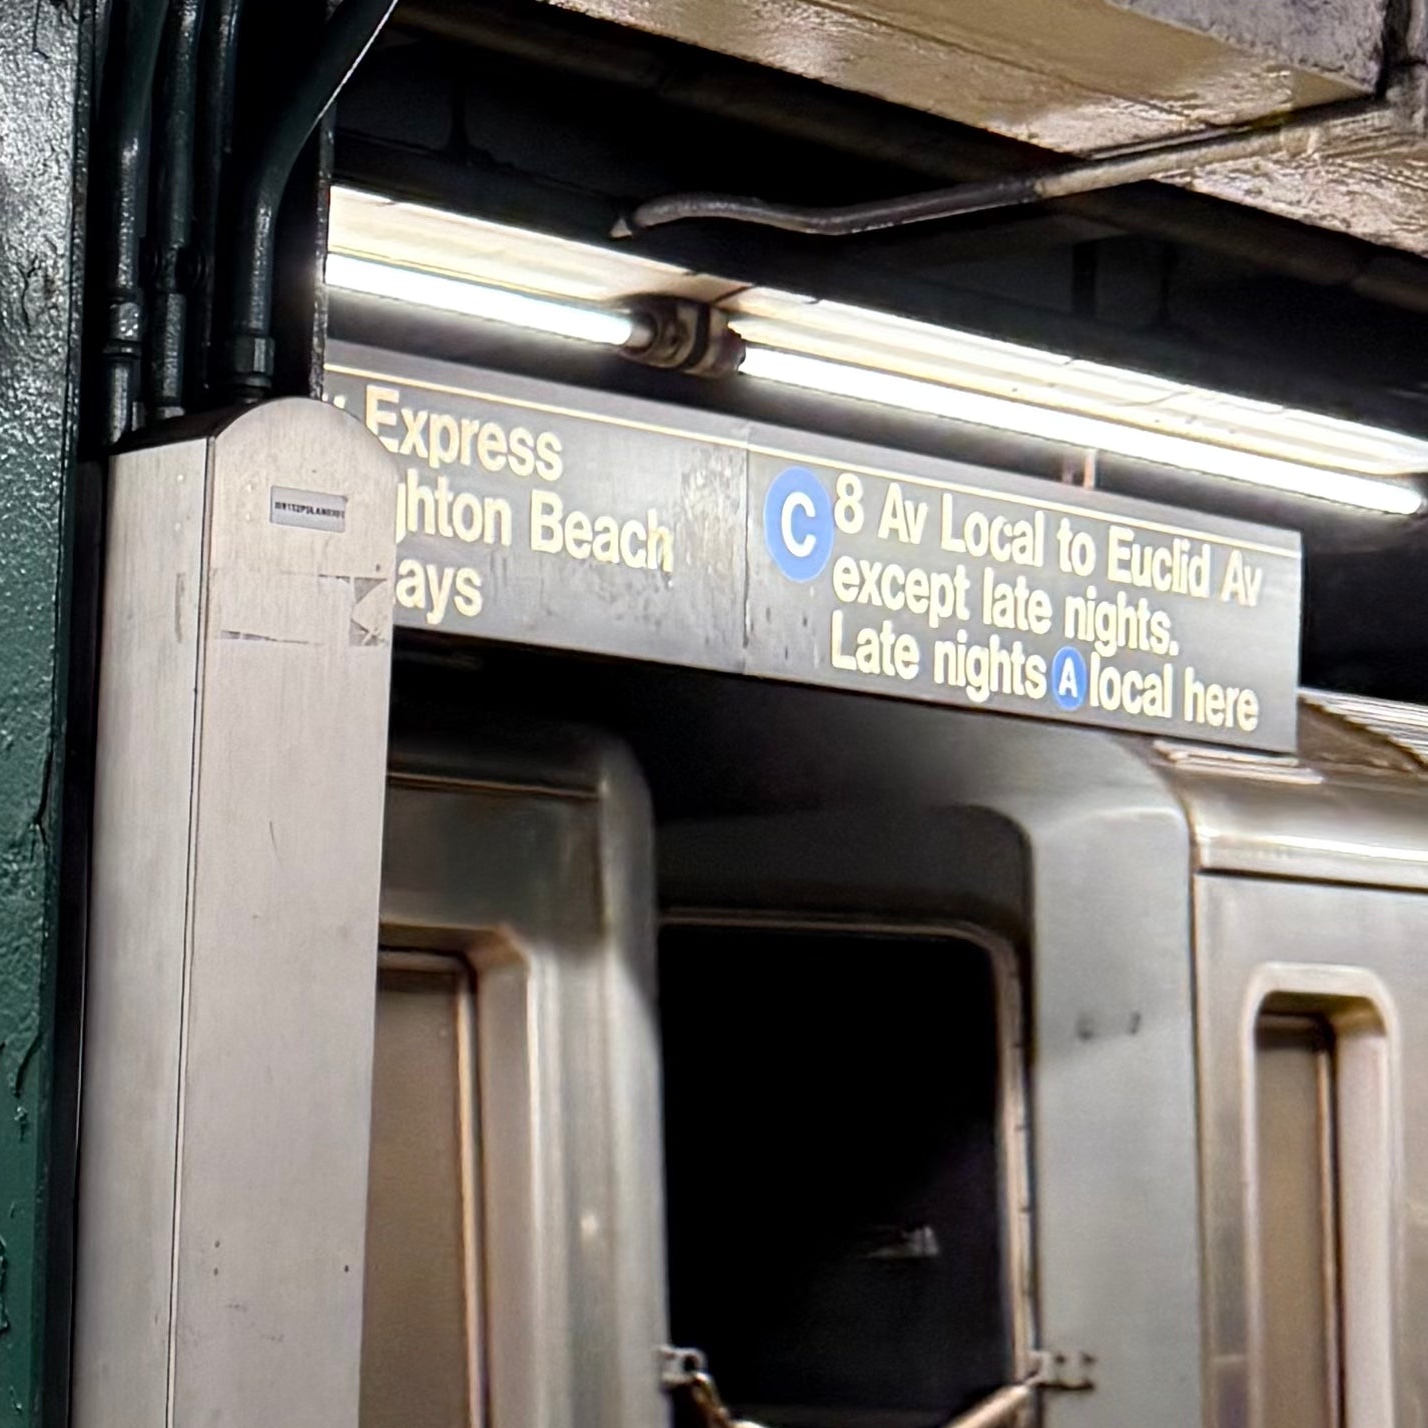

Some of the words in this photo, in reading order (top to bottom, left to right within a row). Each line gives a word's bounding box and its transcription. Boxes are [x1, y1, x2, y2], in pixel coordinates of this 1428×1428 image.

[365, 384, 563, 481] Express
[530, 488, 674, 572] Beach
[781, 491, 816, 558] C
[835, 473, 864, 534] 8
[878, 482, 928, 544] Av
[941, 493, 1044, 568] Local
[1057, 517, 1095, 577] to
[1107, 524, 1211, 598] Euclid
[1221, 549, 1263, 607] Av
[396, 557, 484, 625] ays
[832, 554, 970, 628] except
[983, 566, 1052, 635] late
[831, 610, 919, 680] Late
[933, 628, 1047, 702] nights
[1058, 663, 1078, 699] A
[1089, 652, 1173, 719] local
[1184, 666, 1260, 731] here
